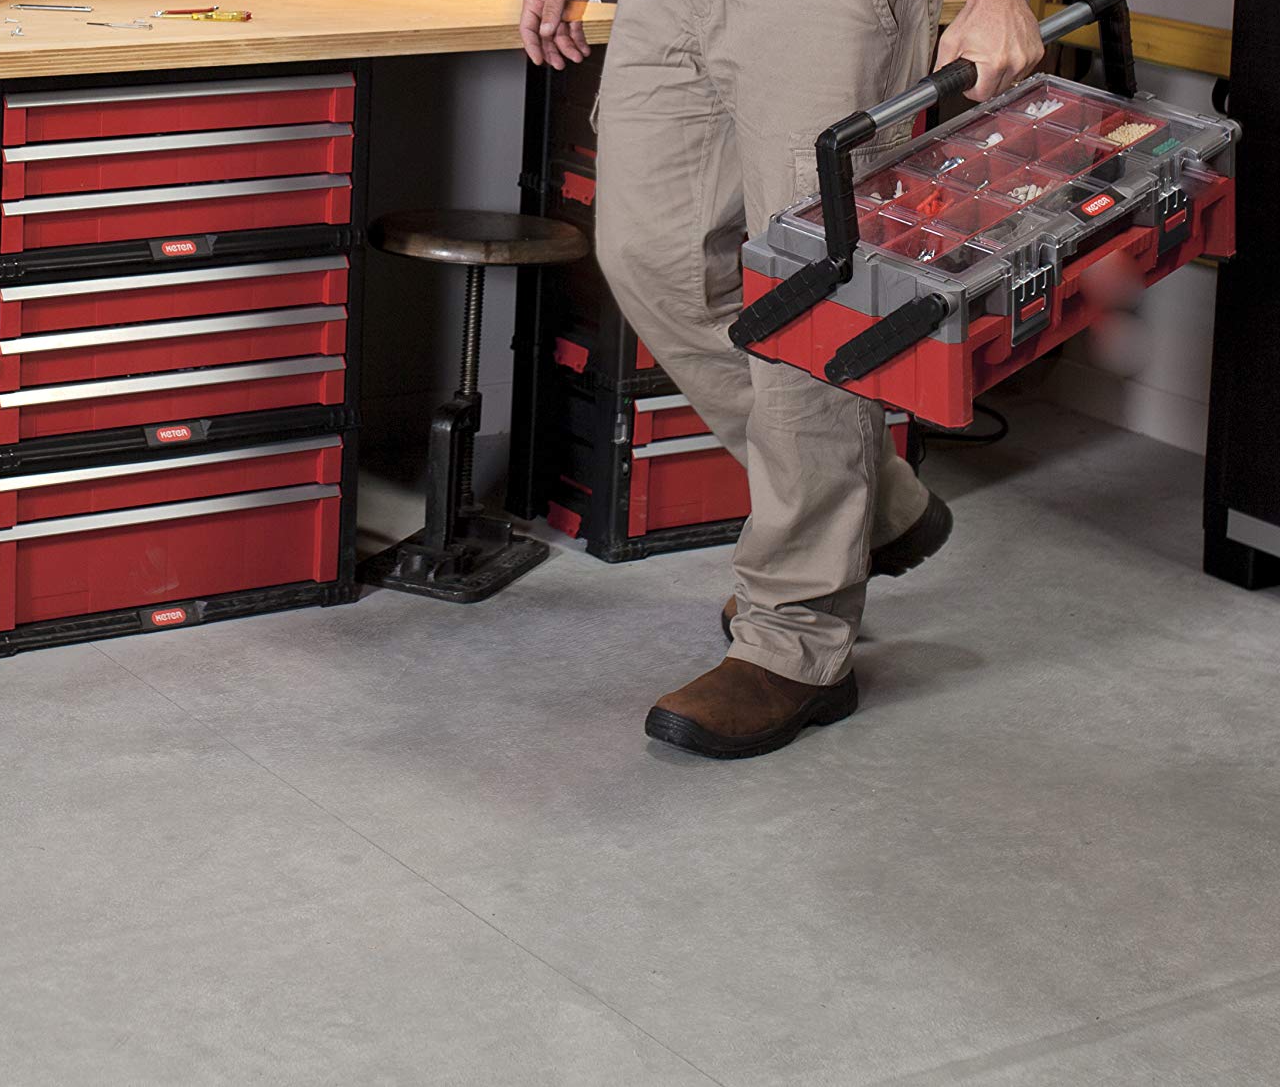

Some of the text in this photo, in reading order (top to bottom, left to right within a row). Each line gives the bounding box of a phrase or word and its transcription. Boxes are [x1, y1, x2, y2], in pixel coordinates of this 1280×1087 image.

[1084, 196, 1111, 214] KETER
[164, 242, 194, 253] KETER
[159, 428, 188, 439] KETER
[154, 610, 183, 622] KETER
